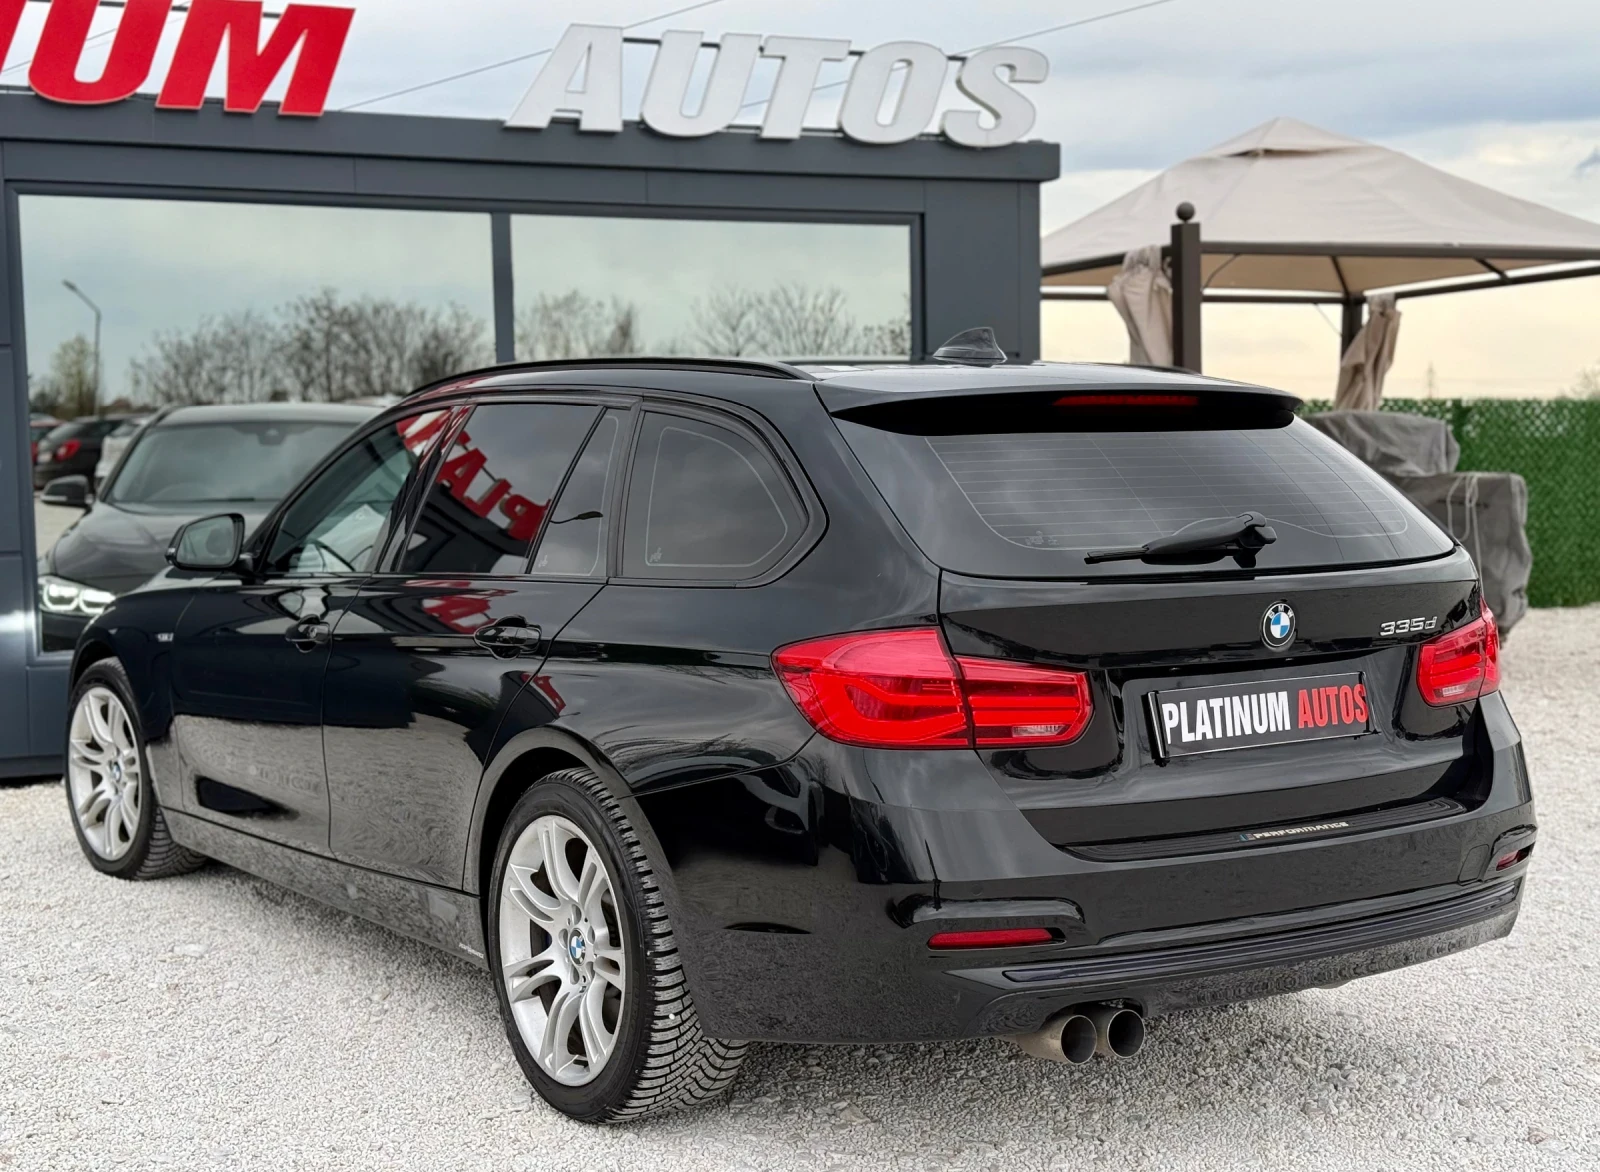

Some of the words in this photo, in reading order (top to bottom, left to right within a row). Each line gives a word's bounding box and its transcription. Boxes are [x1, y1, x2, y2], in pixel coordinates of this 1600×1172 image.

[0, 0, 356, 117] UM
[503, 23, 1050, 148] AUTOS
[1380, 616, 1438, 636] 335d
